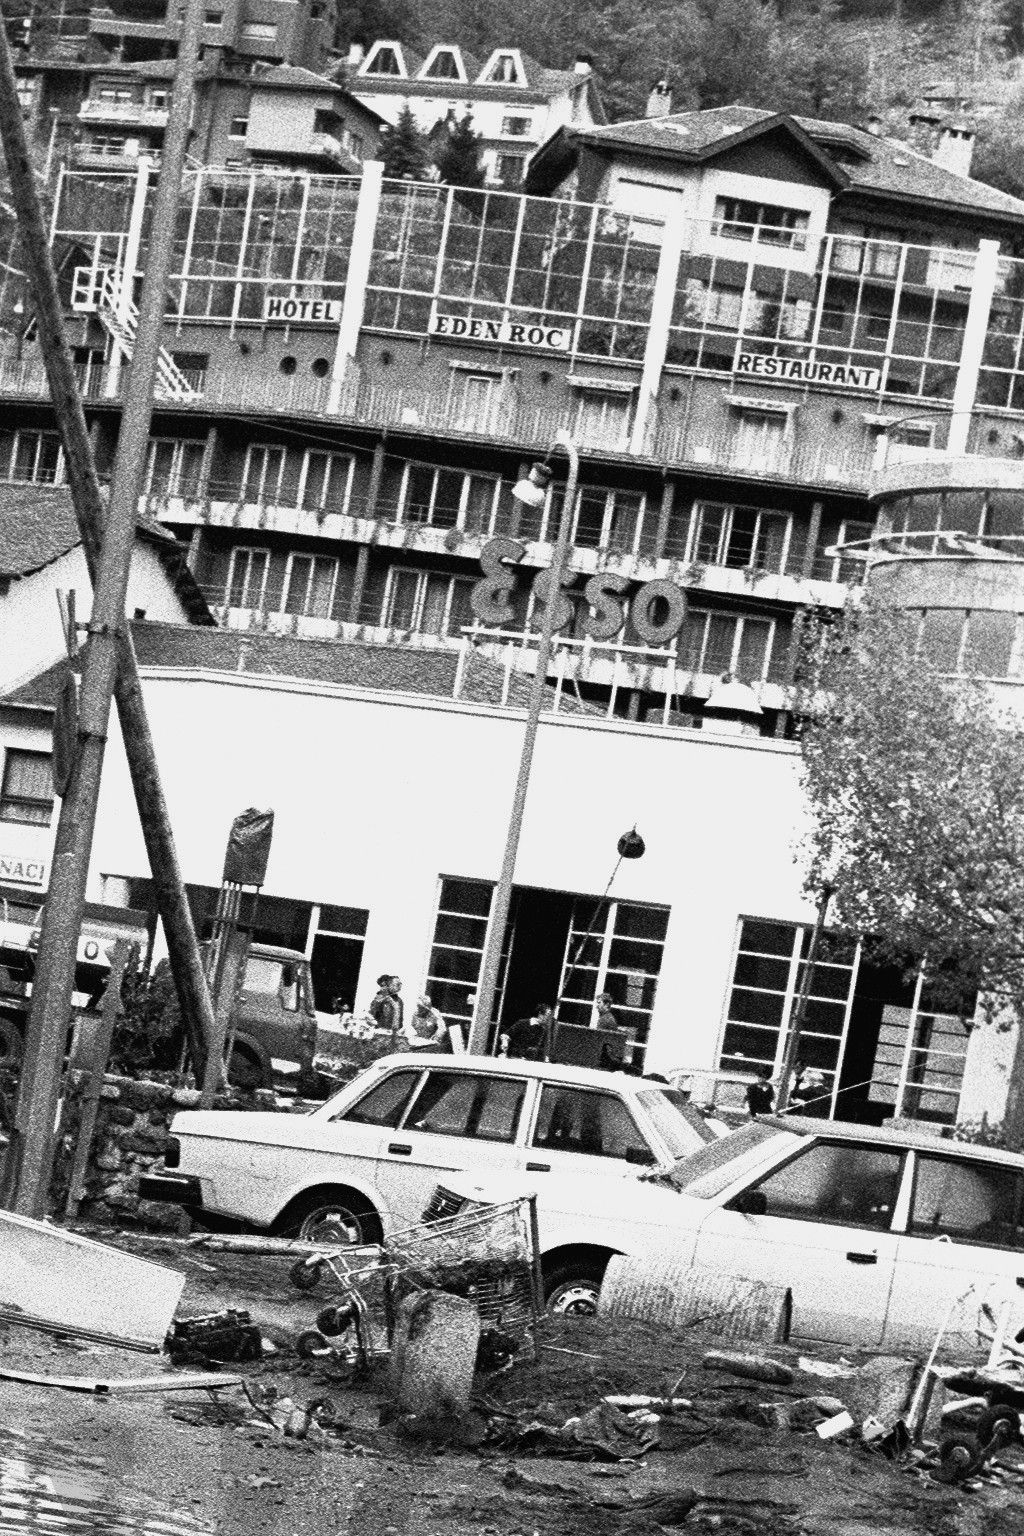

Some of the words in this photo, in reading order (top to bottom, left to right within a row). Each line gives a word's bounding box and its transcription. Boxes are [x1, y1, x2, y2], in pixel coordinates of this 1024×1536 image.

[267, 299, 334, 321] HOTEL
[434, 316, 503, 340] EDEN
[508, 322, 564, 347] ROC
[737, 354, 875, 387] RESTAURANT
